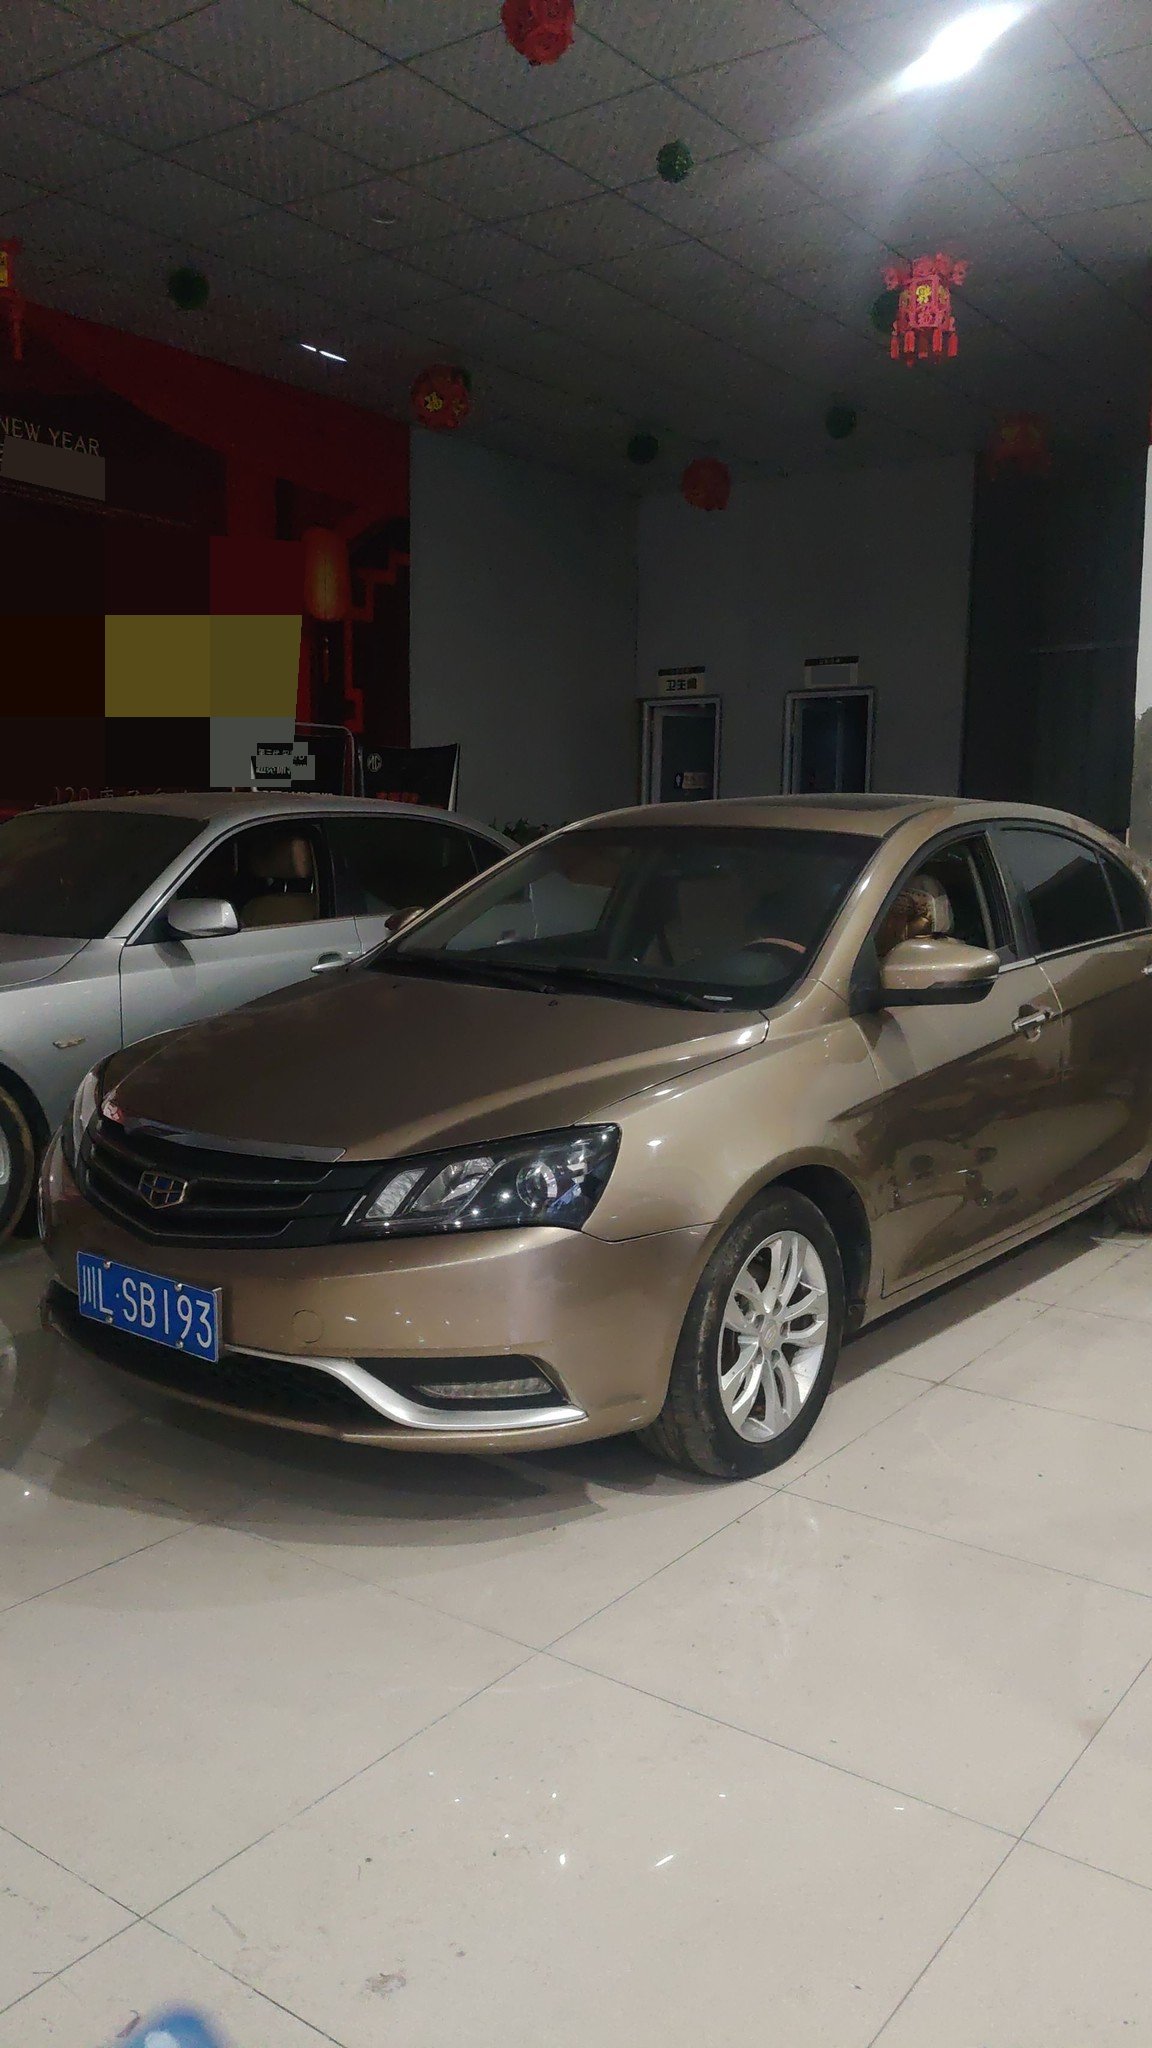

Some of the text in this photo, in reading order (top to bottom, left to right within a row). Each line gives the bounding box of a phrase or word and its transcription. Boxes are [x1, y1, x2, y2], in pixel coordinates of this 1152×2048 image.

[0, 416, 100, 456] NEW YEAR
[367, 754, 382, 771] MG
